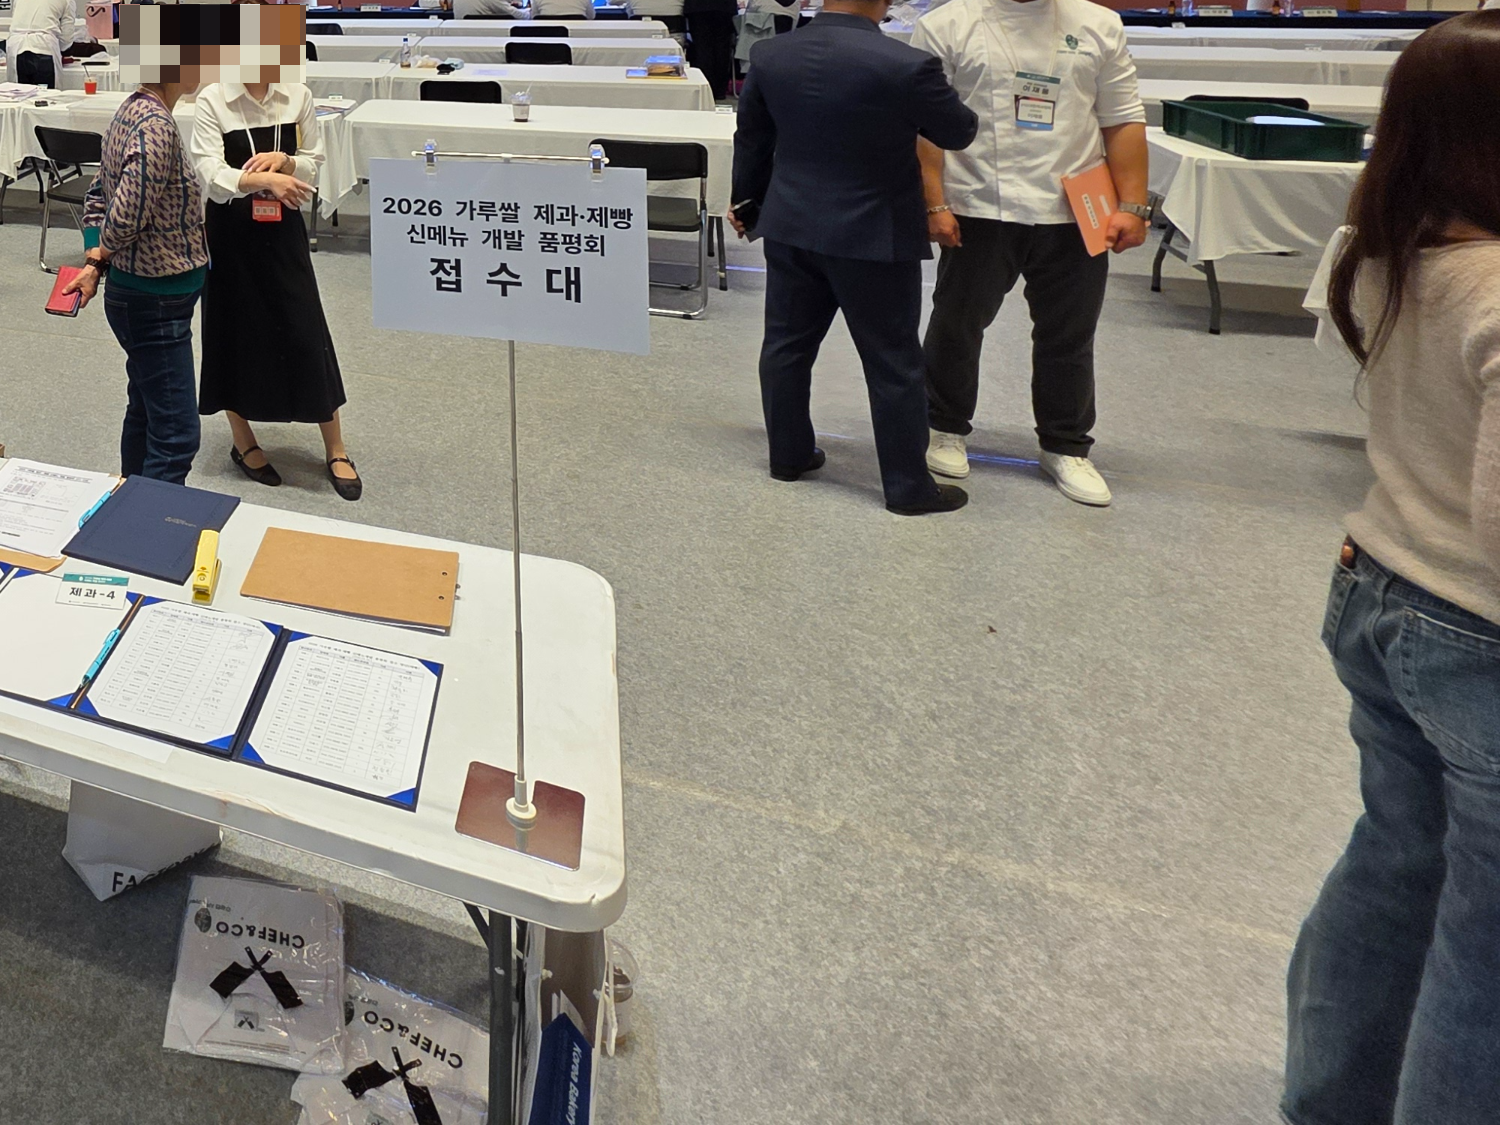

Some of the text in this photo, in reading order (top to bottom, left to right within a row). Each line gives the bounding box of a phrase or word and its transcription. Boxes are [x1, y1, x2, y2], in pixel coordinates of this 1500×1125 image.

[382, 197, 634, 230] 2026 가루쌀 제과·제빵
[406, 223, 606, 257] 신메뉴 개발 품평회
[216, 921, 305, 949] CHEF&CO
[364, 1010, 464, 1069] CHEF&CO
[565, 1041, 583, 1125] Korea Bakery
